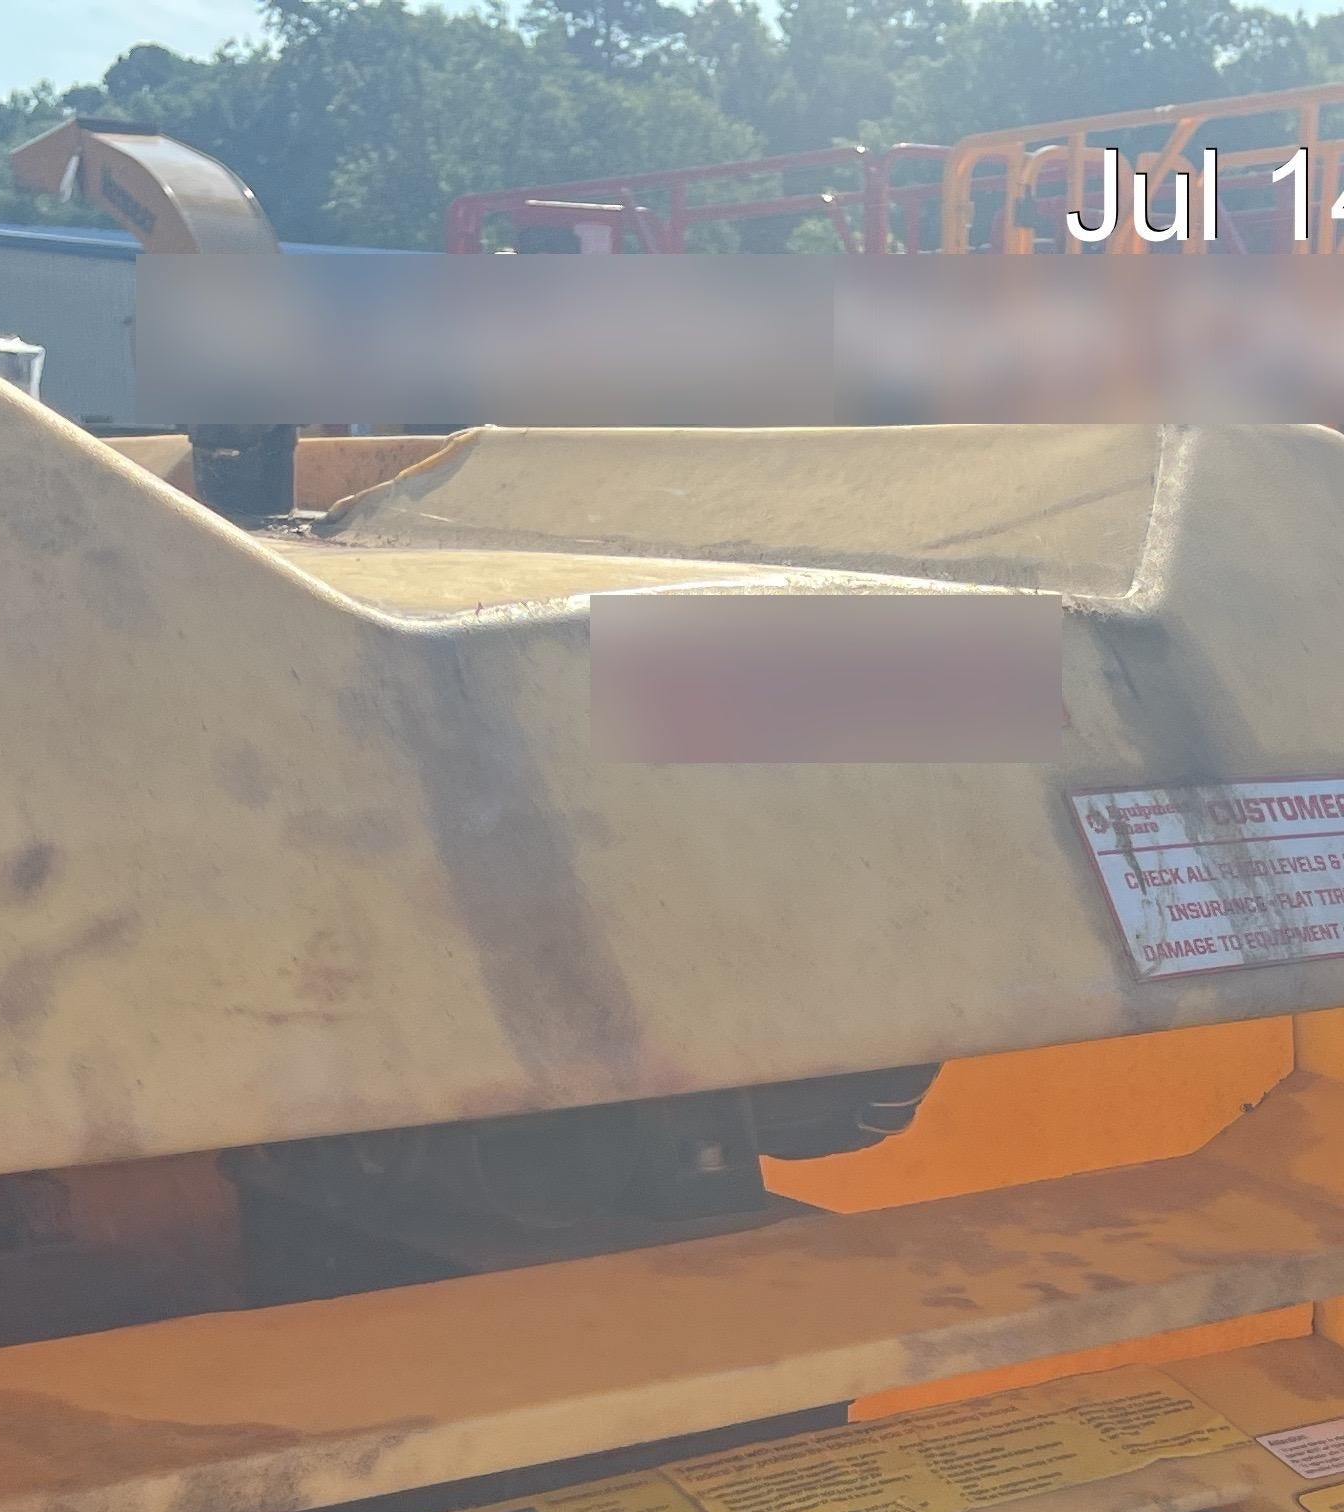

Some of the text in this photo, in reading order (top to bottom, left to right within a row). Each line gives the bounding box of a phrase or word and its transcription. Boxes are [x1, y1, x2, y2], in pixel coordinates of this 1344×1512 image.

[1123, 866, 1185, 890] CHECK
[1186, 865, 1217, 884] ALL
[1268, 855, 1328, 876] LEVELS
[1330, 854, 1342, 871] &
[1166, 896, 1268, 922] INSURANCE
[1277, 889, 1313, 910] FLAT
[1142, 936, 1218, 962] DAMAGE
[1217, 934, 1243, 952] TO
[1243, 922, 1343, 950] EQUIPMENT
